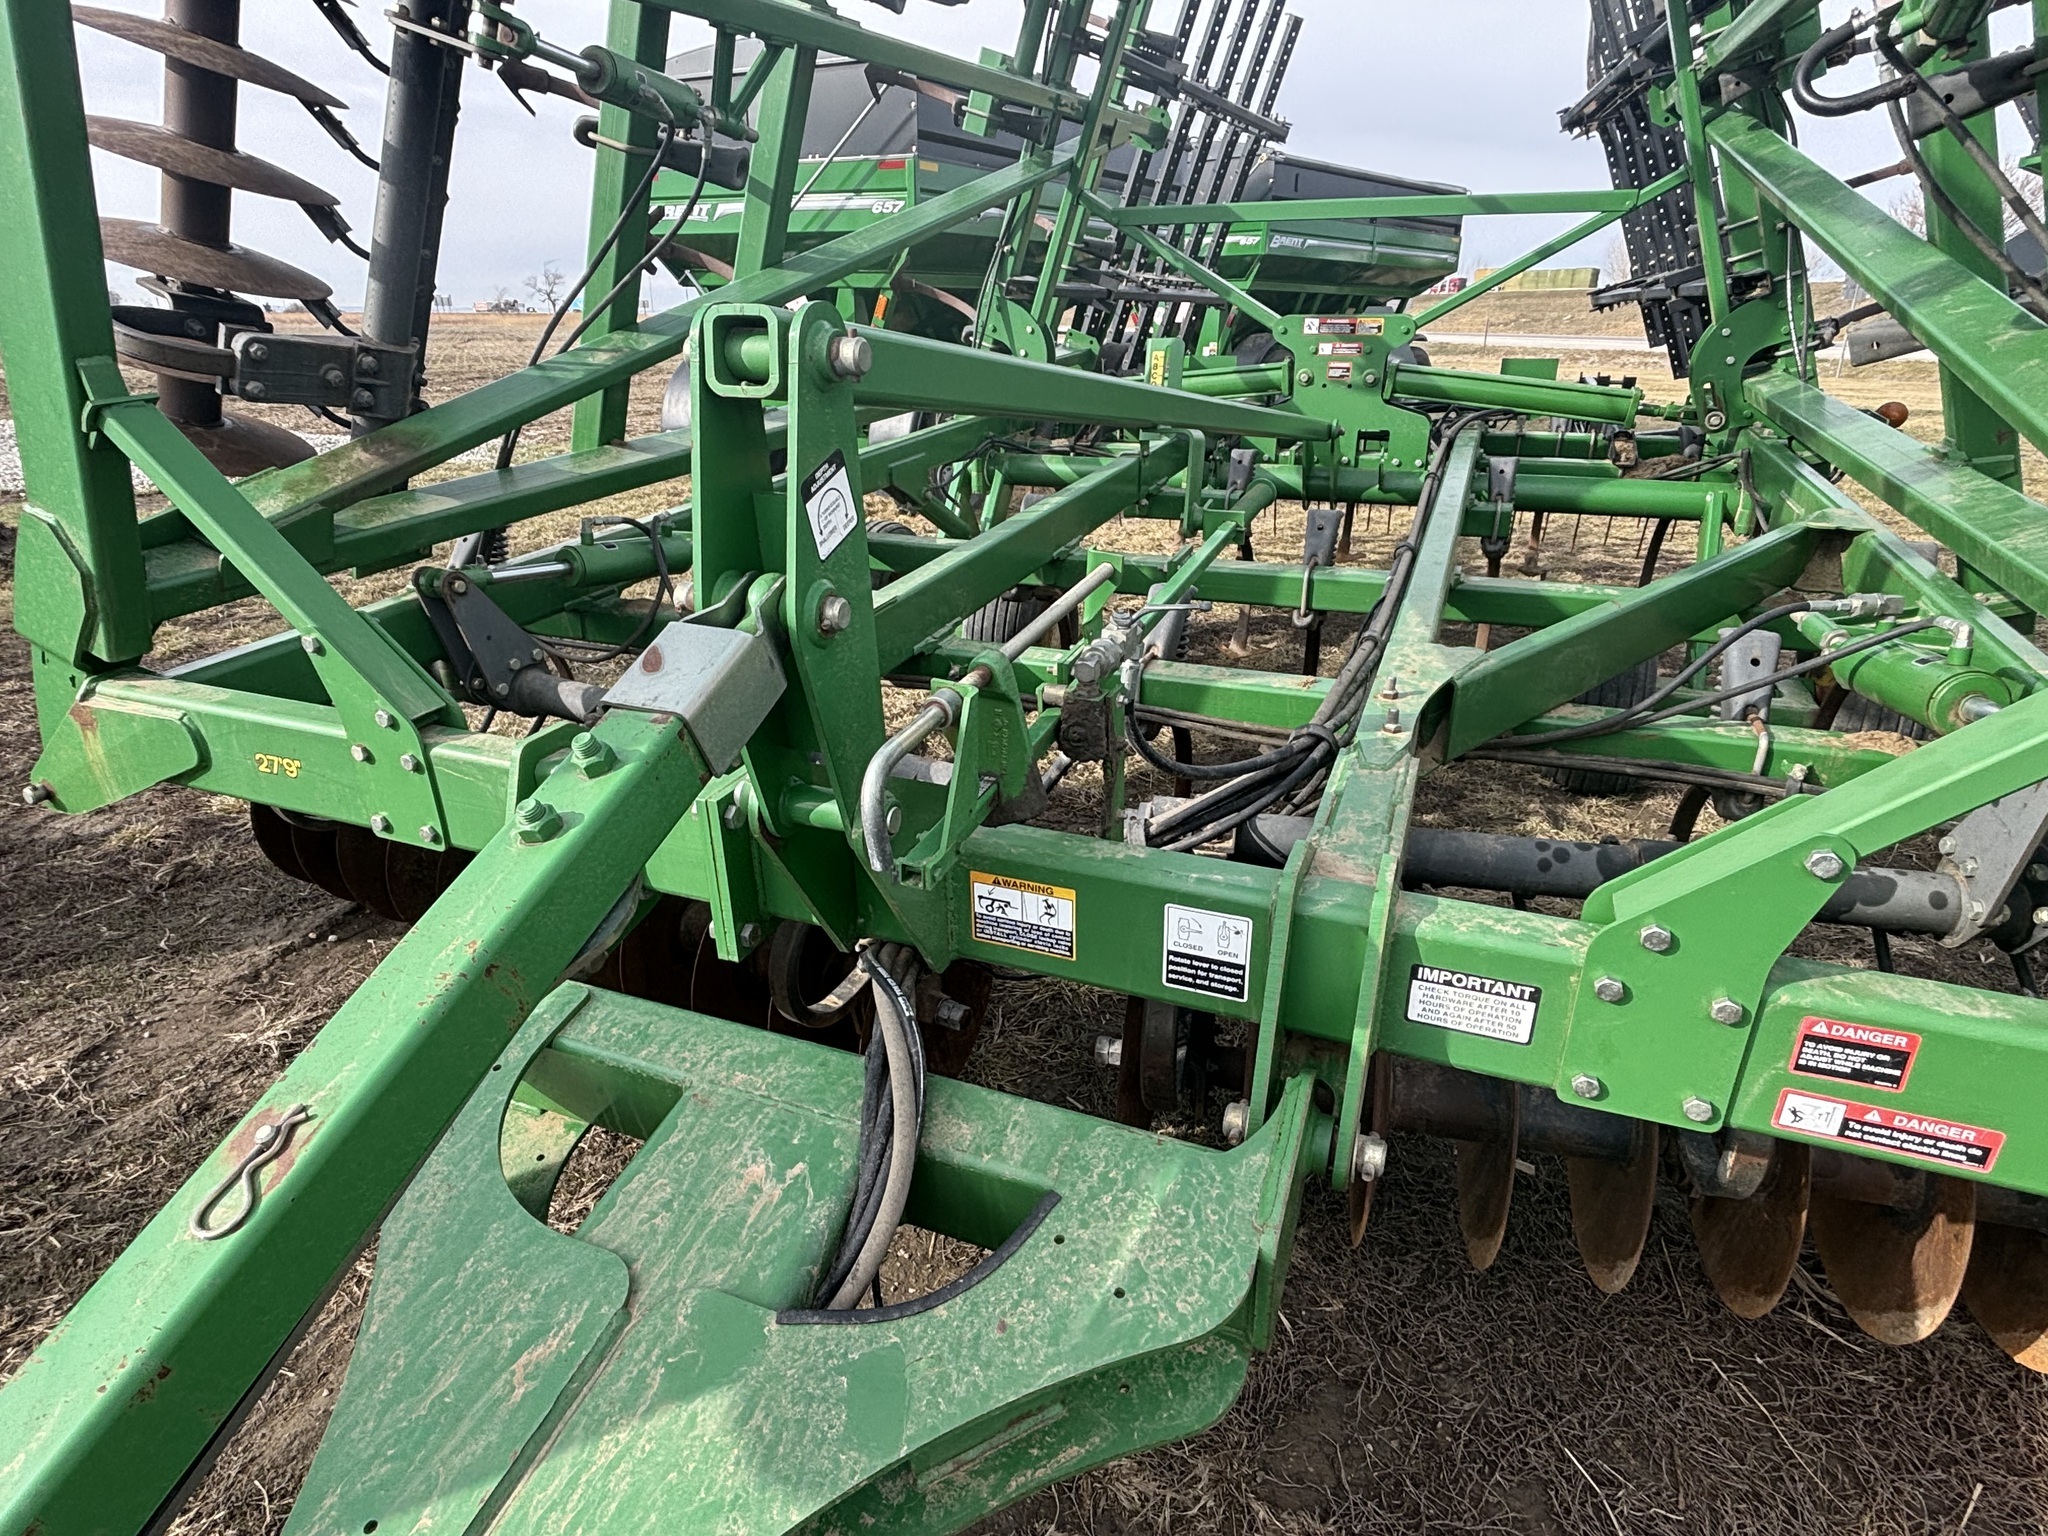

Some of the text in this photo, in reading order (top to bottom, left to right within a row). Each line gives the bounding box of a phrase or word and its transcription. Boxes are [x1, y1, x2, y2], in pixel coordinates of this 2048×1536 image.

[871, 201, 905, 213] 657
[1270, 235, 1304, 247] BRENT
[1001, 879, 1054, 895] WARNING
[1173, 941, 1203, 951] CLOSED
[1217, 950, 1238, 958] OPEN
[1168, 965, 1196, 974] position
[1209, 972, 1243, 985] transport,
[1169, 955, 1191, 964] Rotate
[1192, 960, 1210, 968] lever
[1220, 966, 1243, 975] closed
[1168, 973, 1239, 992] service, and storage.
[1417, 967, 1535, 1000] IMPORTANT
[1418, 985, 1527, 1011] CHECK TORQUE ON ALL
[1422, 993, 1474, 1007] HARDWARE
[1477, 1002, 1508, 1014] AFTER
[1419, 999, 1450, 1010] HOURS
[1468, 1009, 1522, 1024] OPERATION
[1421, 1007, 1440, 1015] AND
[1443, 1011, 1472, 1021] AGAIN
[1474, 1017, 1503, 1028] AFTER
[1417, 1013, 1448, 1024] HOURS
[1466, 1023, 1519, 1038] OPERATION
[1831, 1025, 1908, 1047] DANGER
[1802, 1047, 1831, 1058] DEATH,
[1817, 1044, 1843, 1052] AVOID
[1844, 1049, 1876, 1058] INJURY
[1800, 1053, 1901, 1076] ADJUST WHILE MACHINE
[1818, 1062, 1851, 1073] MOTION
[1848, 1121, 1862, 1129] To
[1862, 1125, 1891, 1136] avoid
[1892, 1131, 1922, 1143] injury
[1936, 1141, 1966, 1152] death
[1967, 1147, 1982, 1155] do
[1893, 1115, 1976, 1141] DANGER
[1863, 1134, 1901, 1147] contact
[1902, 1142, 1940, 1155] electric
